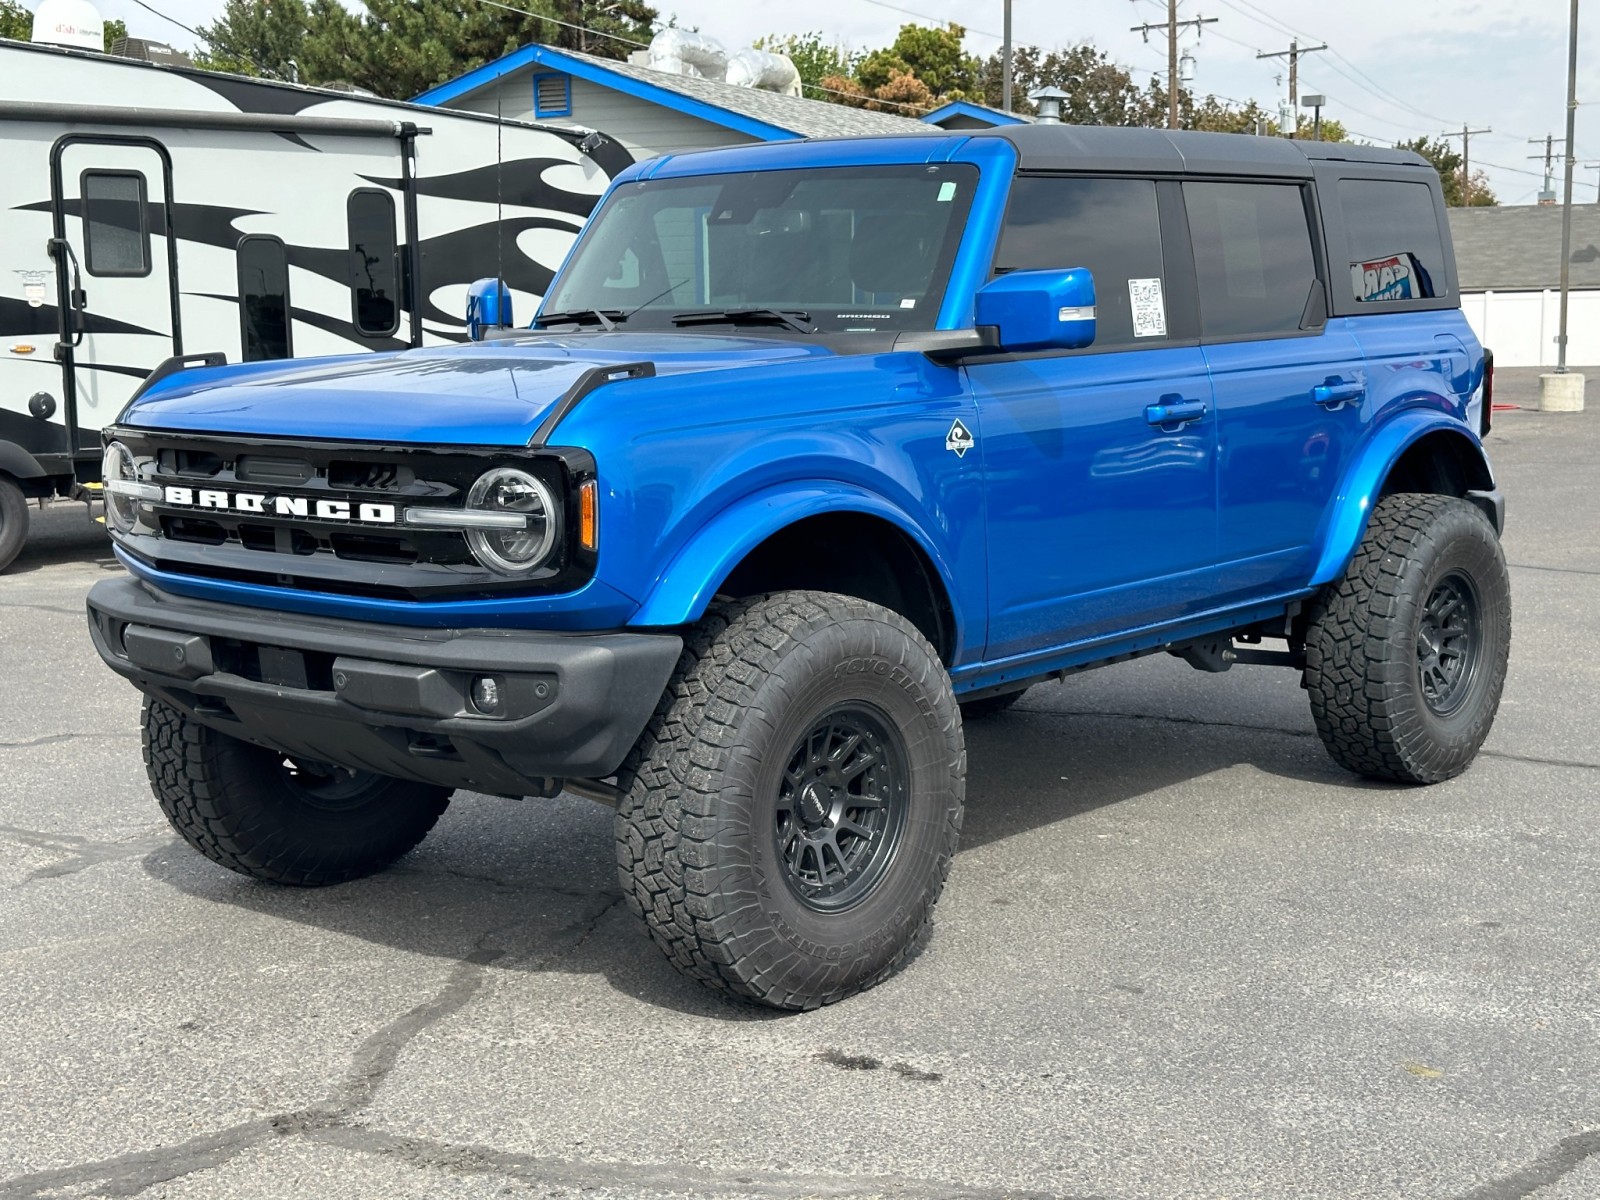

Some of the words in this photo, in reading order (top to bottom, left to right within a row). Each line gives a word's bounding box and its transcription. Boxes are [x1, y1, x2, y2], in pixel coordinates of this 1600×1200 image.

[55, 24, 75, 35] dish
[164, 485, 396, 524] BRONCO
[834, 657, 891, 680] TOYO
[889, 666, 939, 730] TIRES
